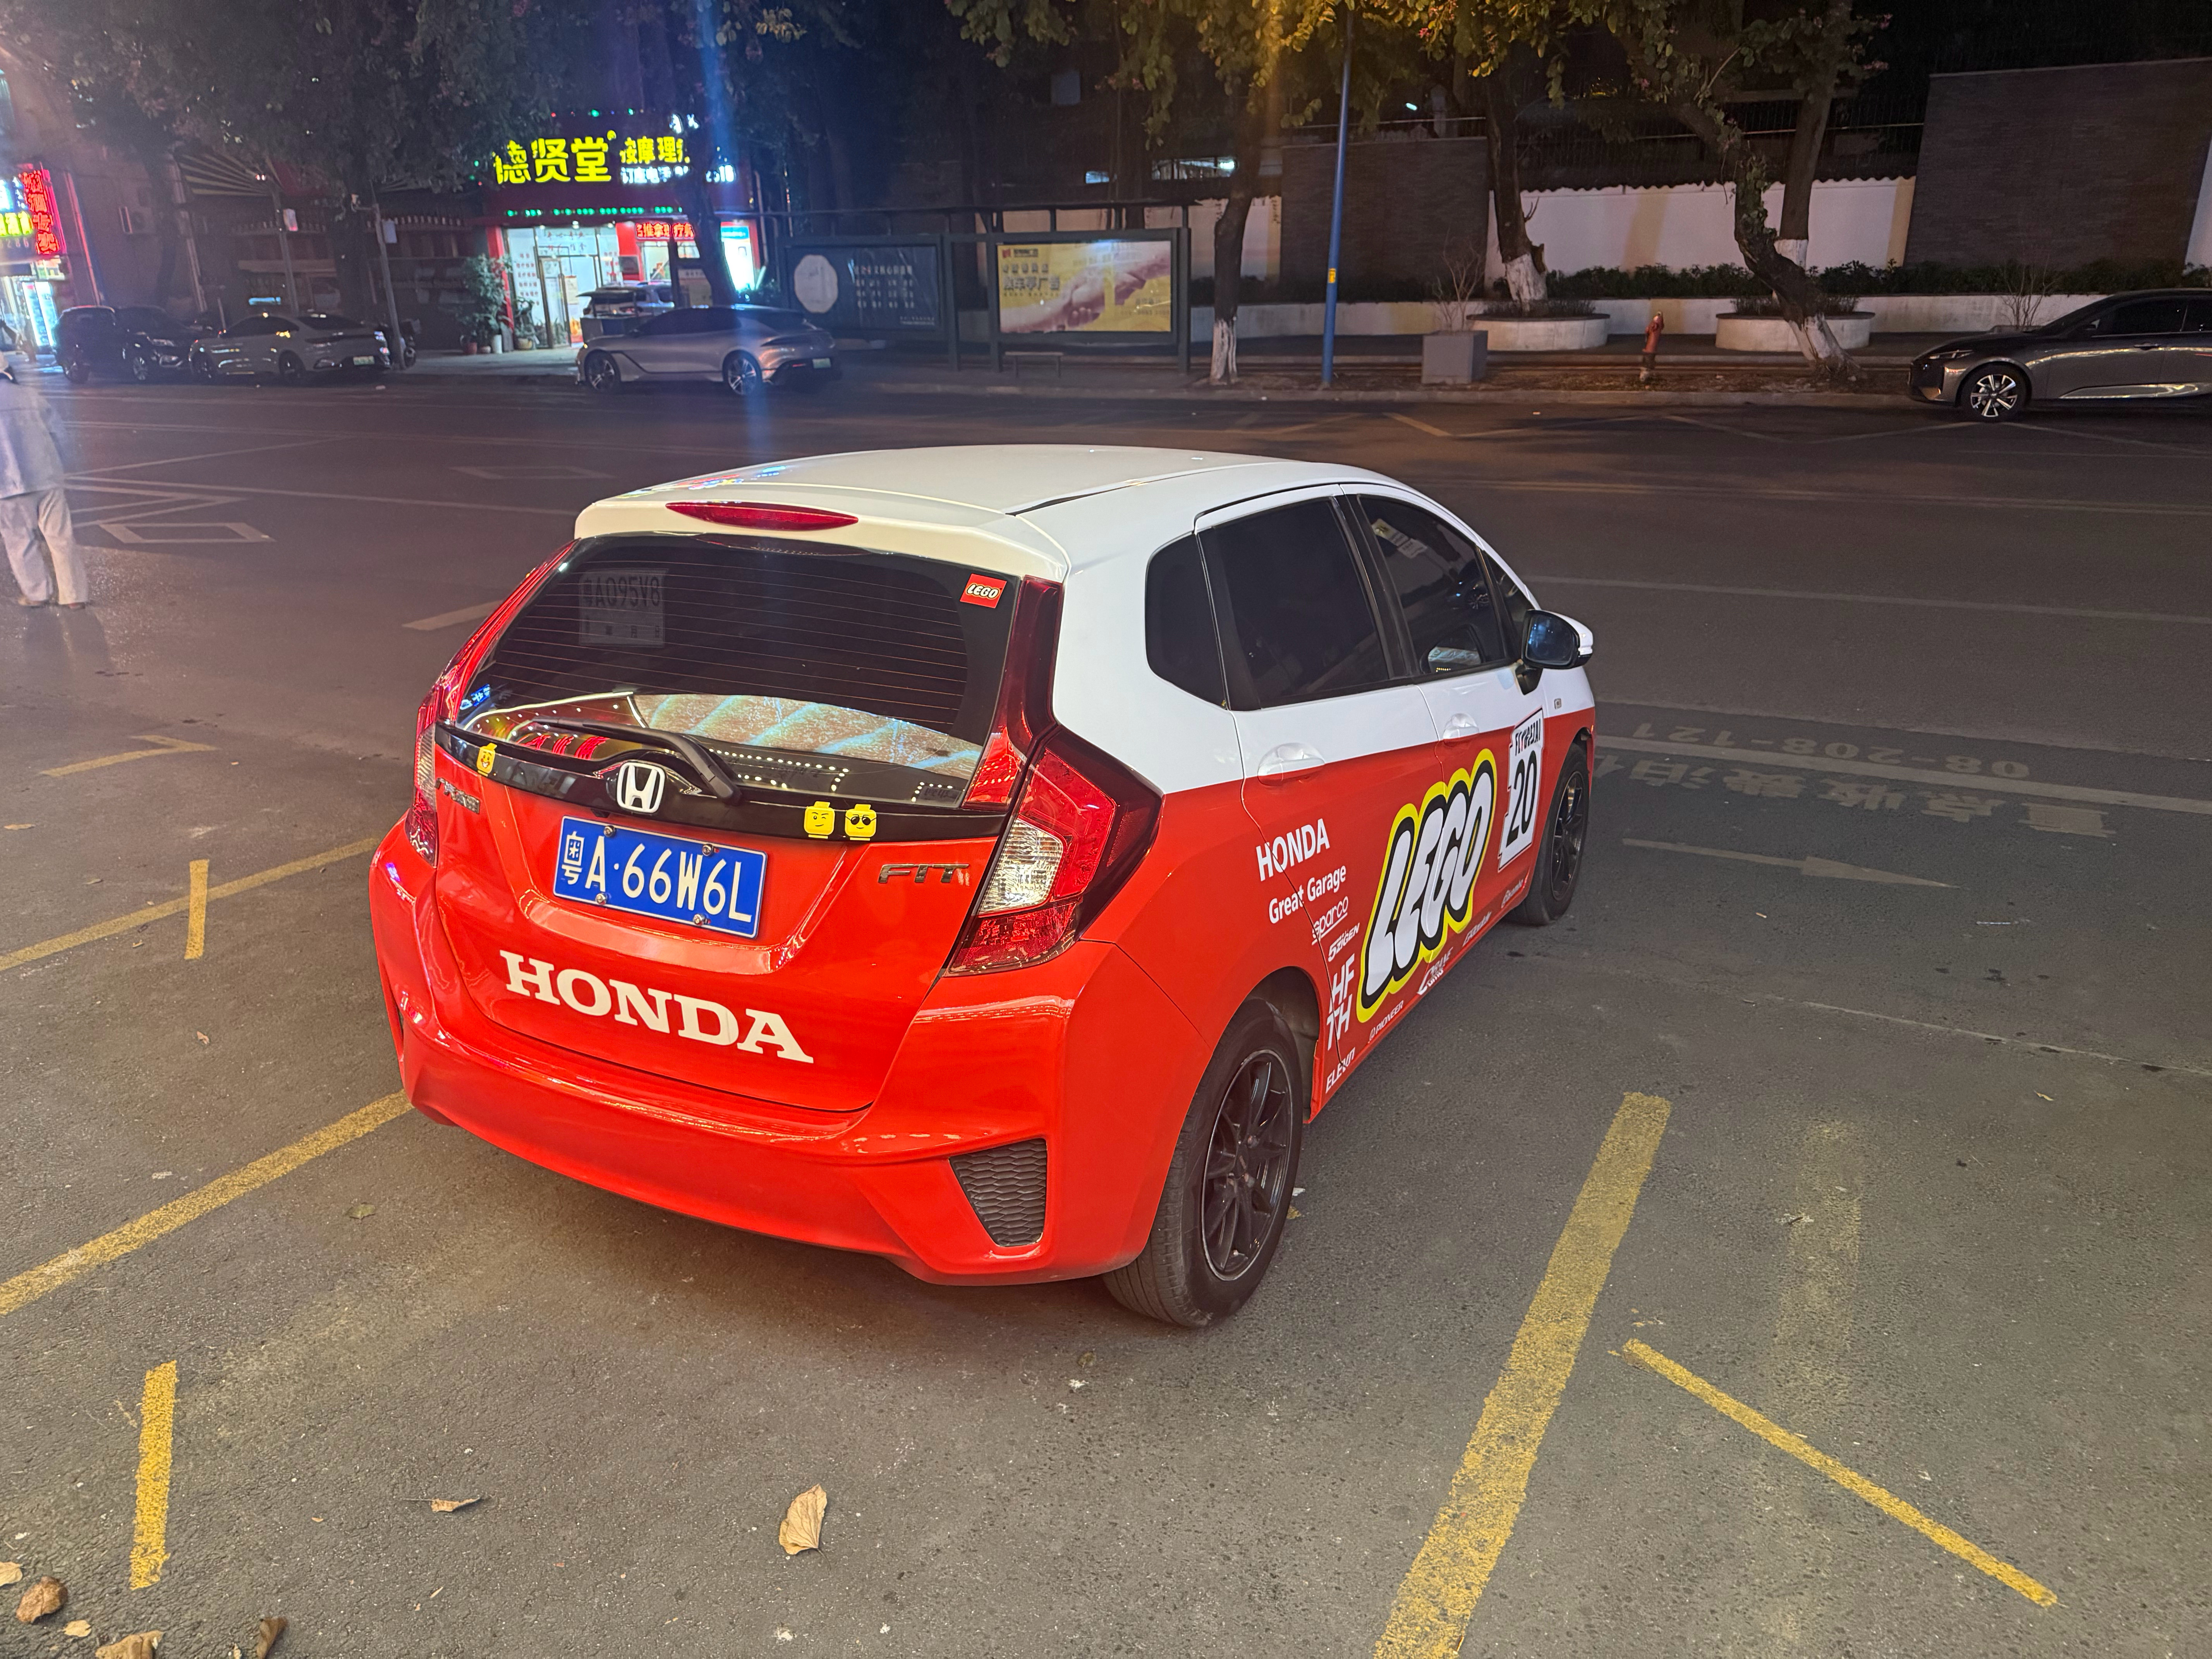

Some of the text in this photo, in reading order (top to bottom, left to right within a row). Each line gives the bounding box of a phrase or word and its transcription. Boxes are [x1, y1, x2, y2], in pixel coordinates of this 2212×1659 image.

[493, 136, 611, 184] 德贤堂
[967, 584, 999, 599] LEGO
[1506, 750, 1537, 848] 20
[1591, 753, 2117, 838] 重点收费泊
[878, 863, 969, 883] FIT
[1255, 818, 1330, 882] HONDA
[1268, 865, 1346, 924] Great Garage
[1361, 759, 1495, 1009] LEGO
[500, 949, 814, 1064] HONDA
[1375, 1000, 1404, 1035] PIONEER
